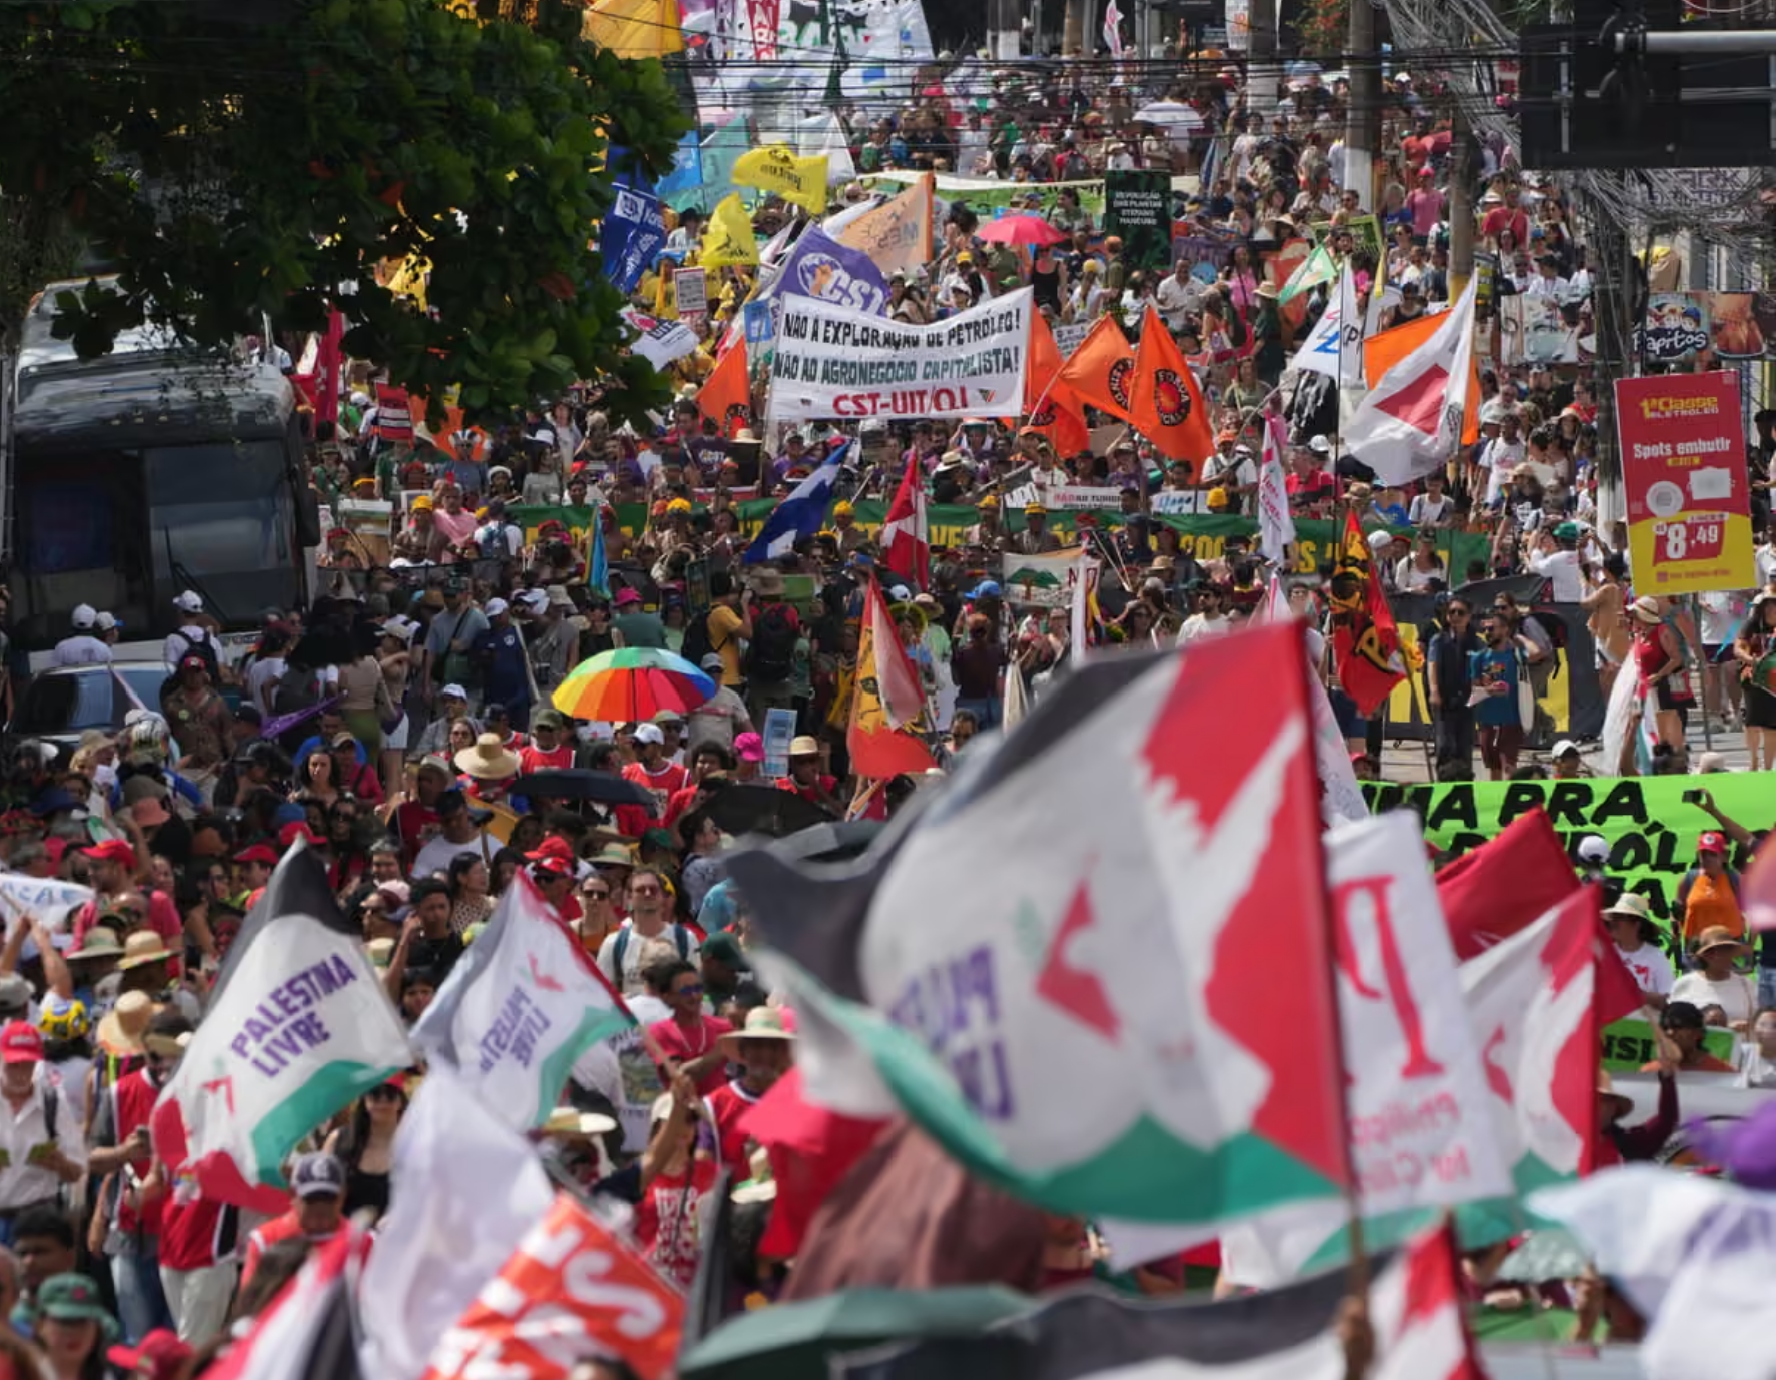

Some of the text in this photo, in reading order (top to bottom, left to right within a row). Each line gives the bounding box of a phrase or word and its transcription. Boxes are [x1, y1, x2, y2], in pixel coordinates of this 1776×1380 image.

[927, 332, 944, 348] DE
[947, 308, 1021, 346] PETRÓLEO!
[801, 357, 818, 382] AO
[922, 345, 1019, 379] CAPITALISTA!
[1633, 436, 1731, 459] Spots embutir
[231, 953, 357, 1059] PALESTINA
[252, 1011, 330, 1078] LIVRE
